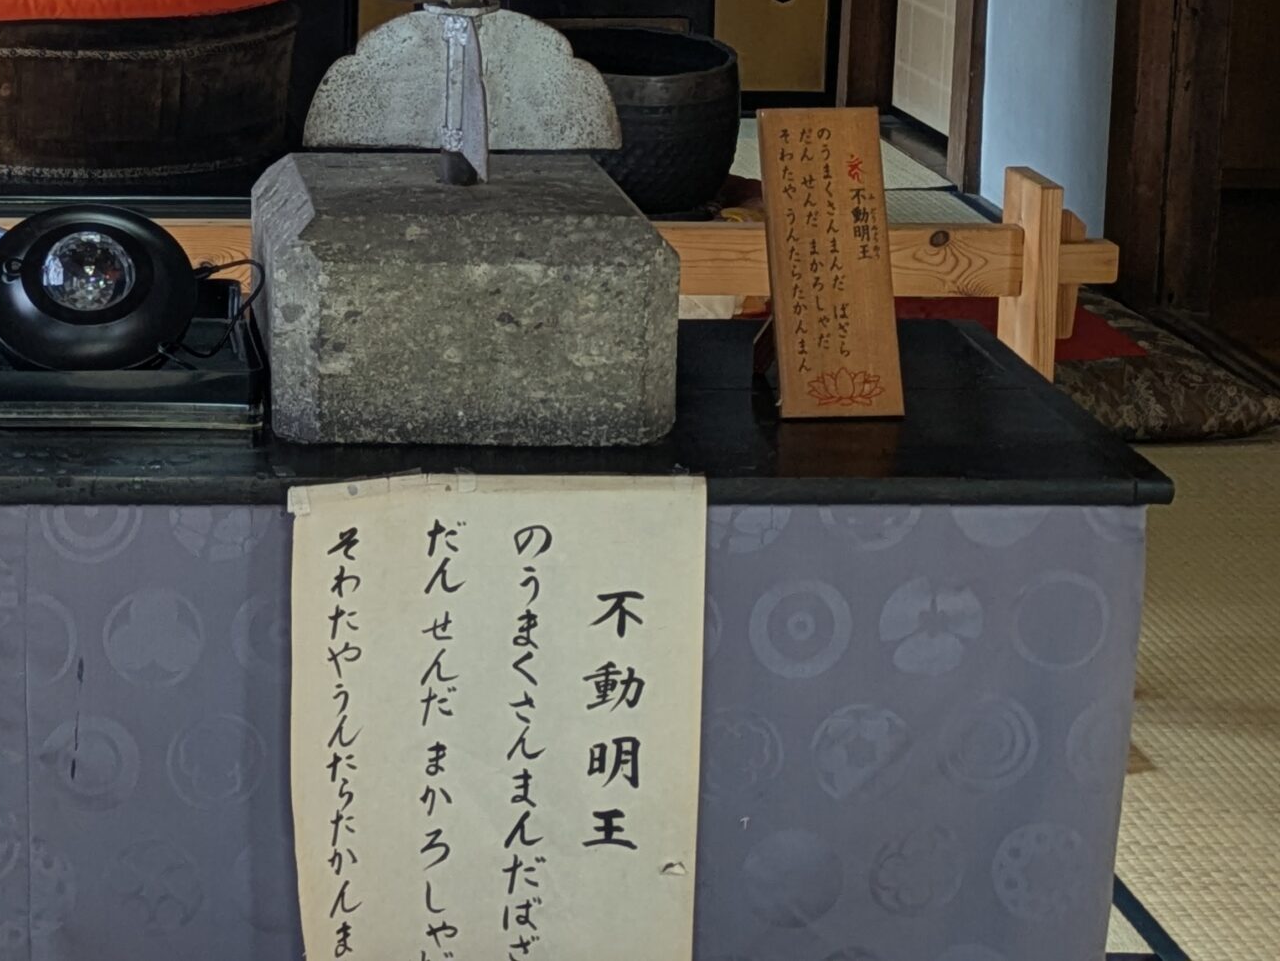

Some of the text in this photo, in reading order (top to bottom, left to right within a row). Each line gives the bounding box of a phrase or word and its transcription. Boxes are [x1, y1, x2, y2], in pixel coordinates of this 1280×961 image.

[849, 188, 873, 261] 不動明王
[581, 590, 646, 851] 不動明王
